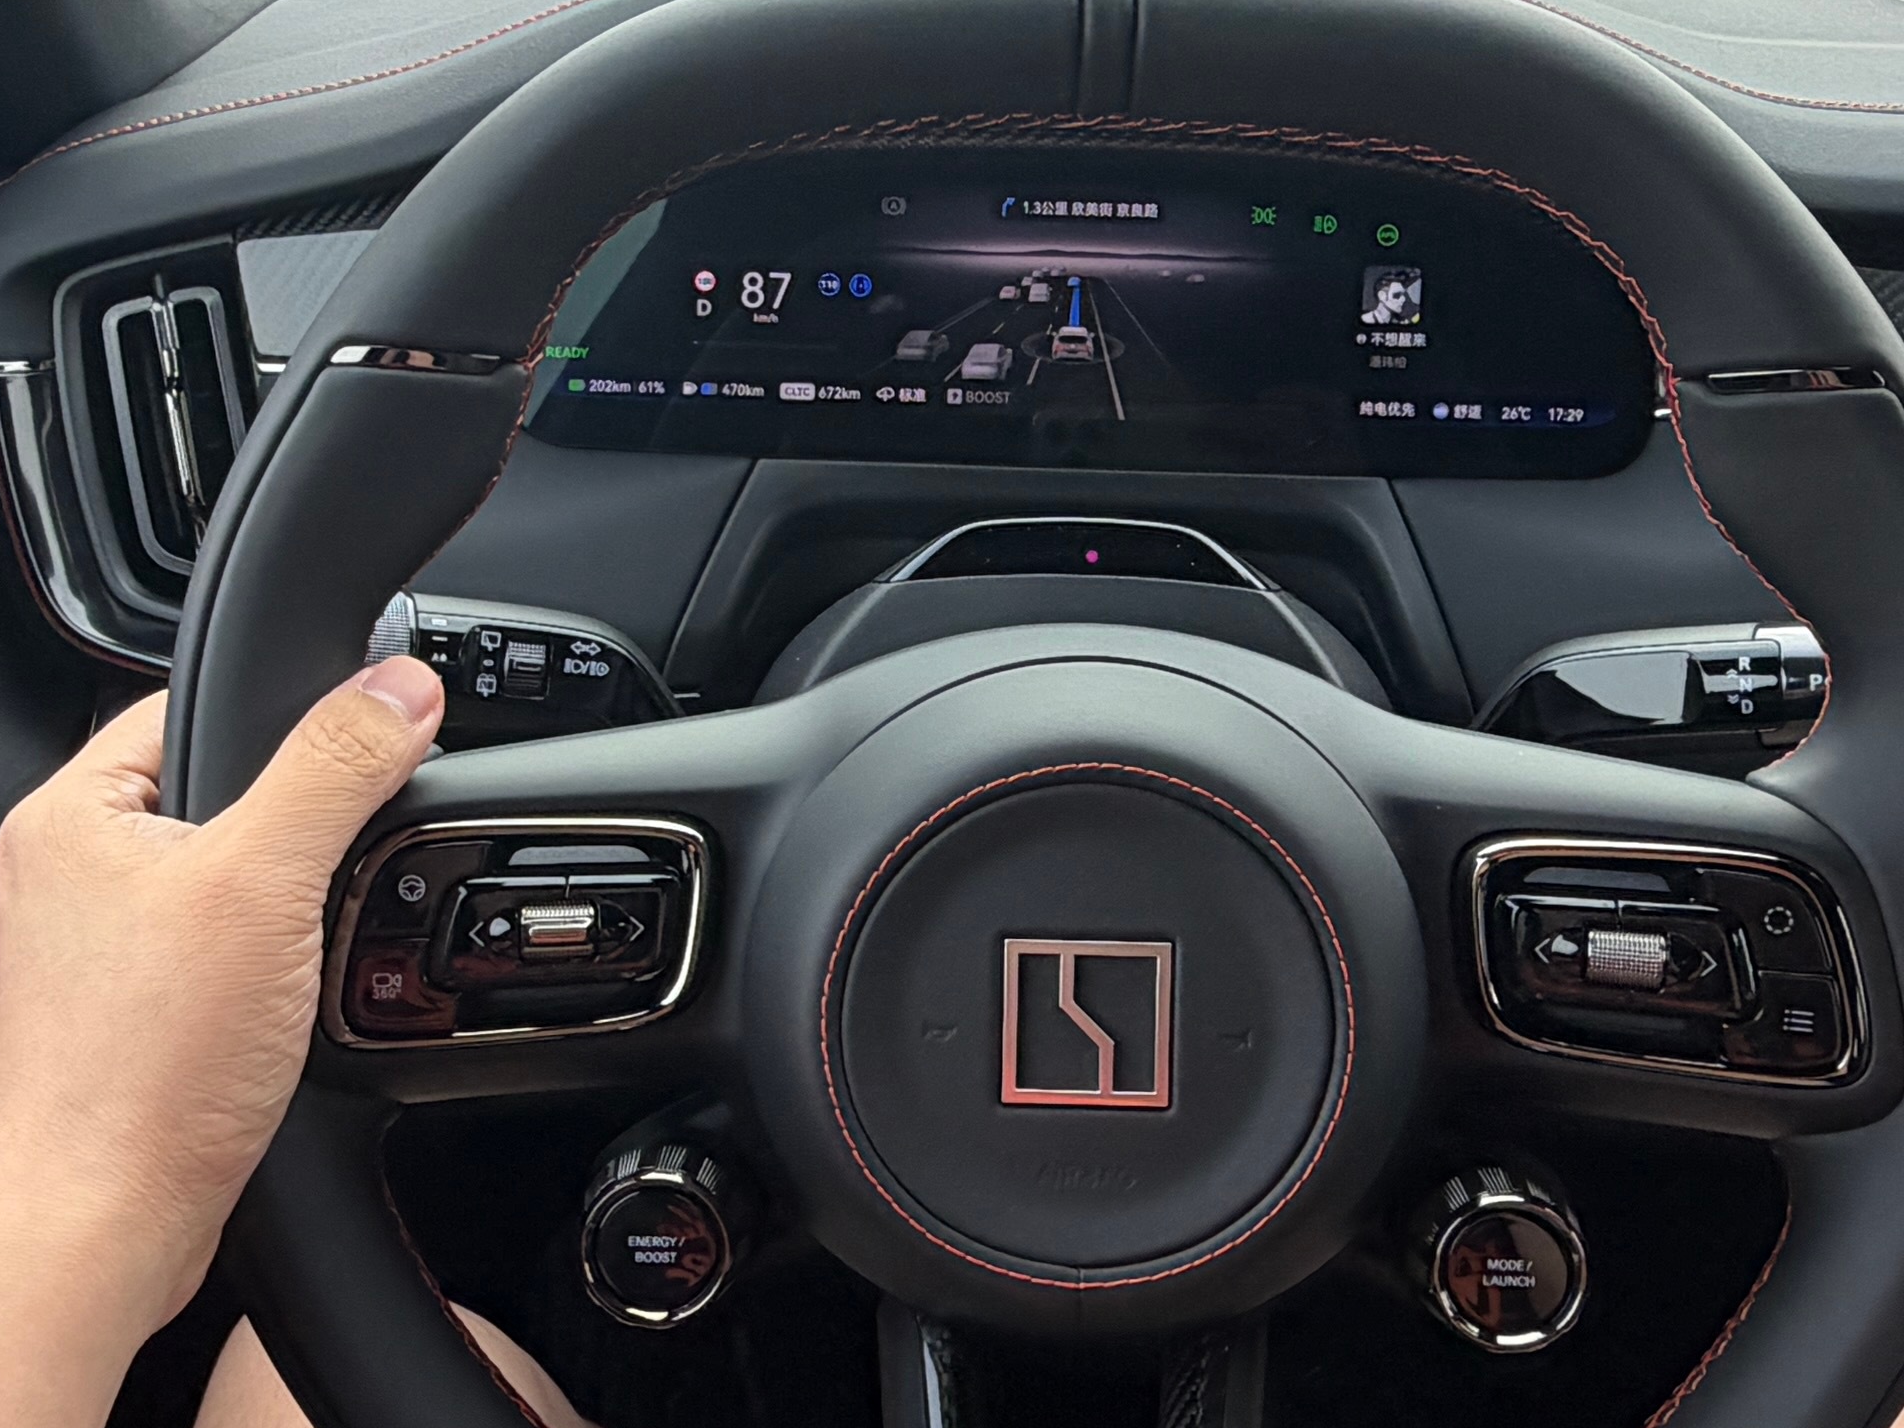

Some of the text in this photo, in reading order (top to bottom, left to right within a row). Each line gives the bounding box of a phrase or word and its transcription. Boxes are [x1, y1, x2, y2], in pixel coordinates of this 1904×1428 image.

[741, 271, 792, 310] 87
[696, 299, 712, 317] D
[545, 345, 590, 360] READY
[589, 379, 632, 394] 202km
[638, 381, 666, 395] 61%
[722, 383, 765, 398] 470km
[818, 386, 862, 401] 672km
[965, 390, 1011, 405] BOOST
[1547, 407, 1585, 424] 17:29
[1738, 656, 1751, 672] R
[1809, 673, 1823, 691] P
[1740, 698, 1754, 714] D
[634, 1251, 678, 1264] BOOST
[1482, 1275, 1536, 1288] LAUNCH
